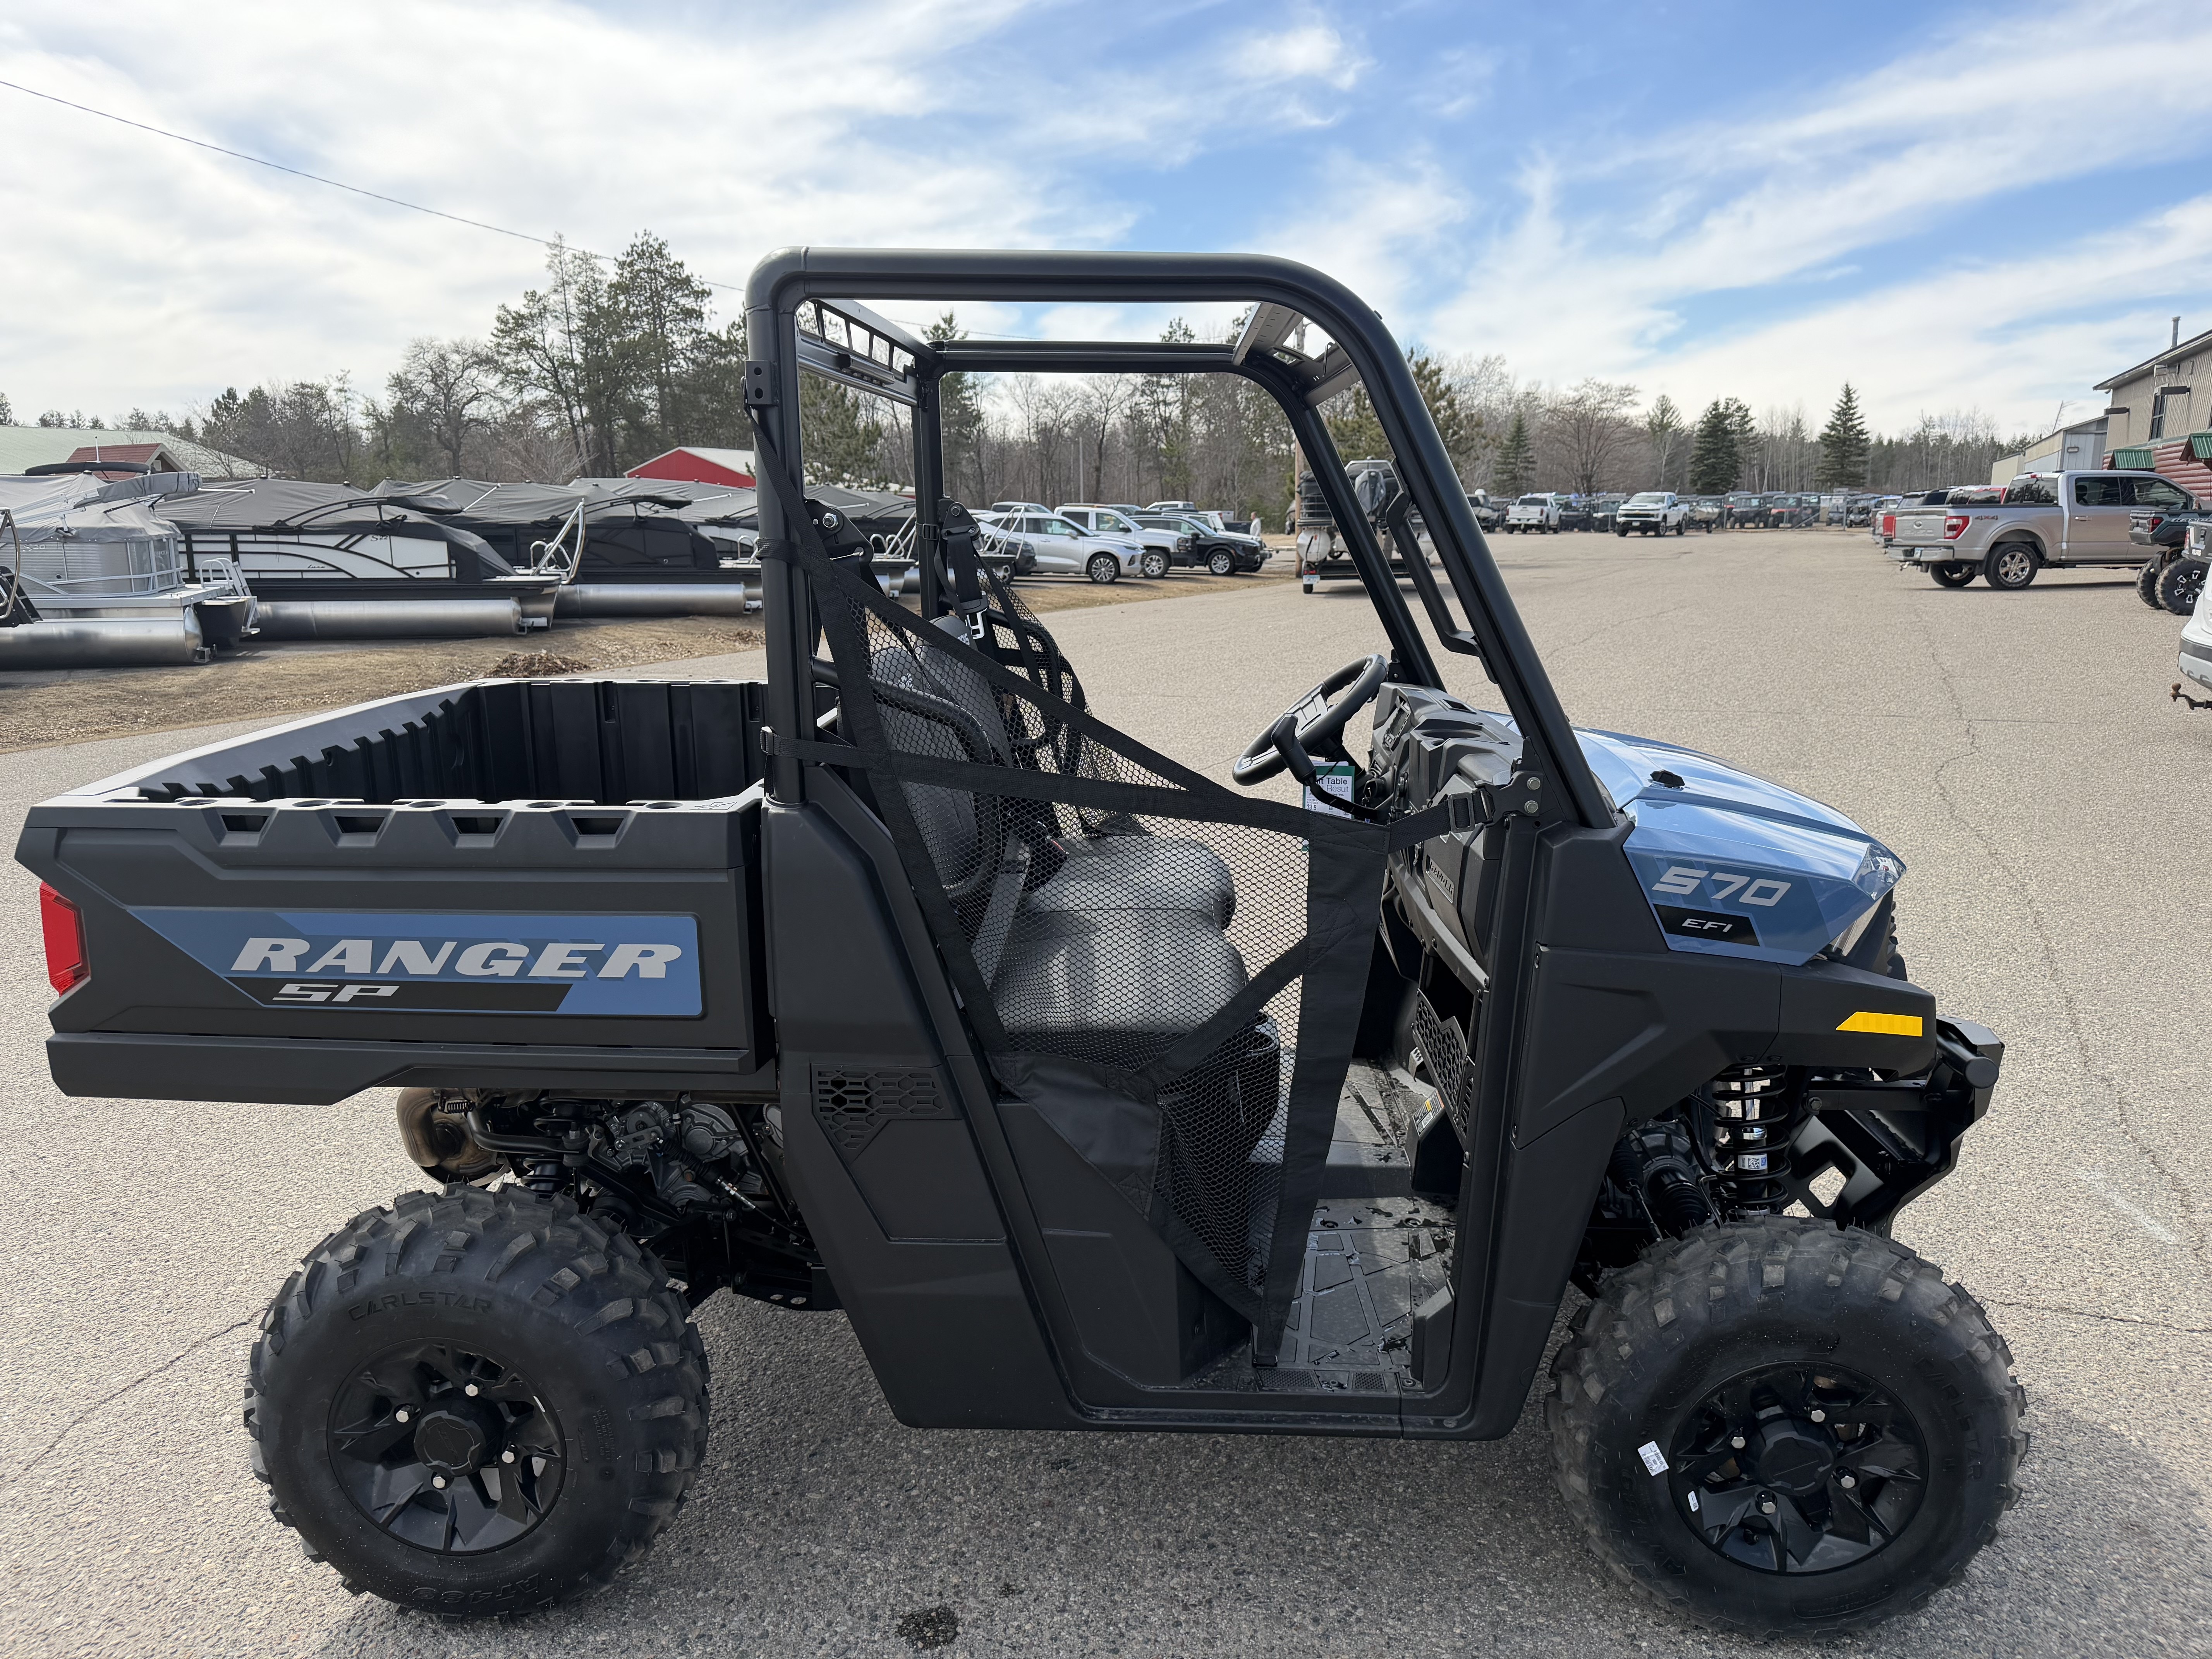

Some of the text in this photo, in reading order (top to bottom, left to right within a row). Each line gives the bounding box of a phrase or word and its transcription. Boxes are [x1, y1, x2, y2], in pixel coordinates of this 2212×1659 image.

[1652, 866, 1791, 907] 570
[1681, 918, 1733, 932] EFI
[230, 937, 682, 979] RANGER
[272, 983, 400, 1003] SP
[347, 1290, 493, 1322] CARLSTAR
